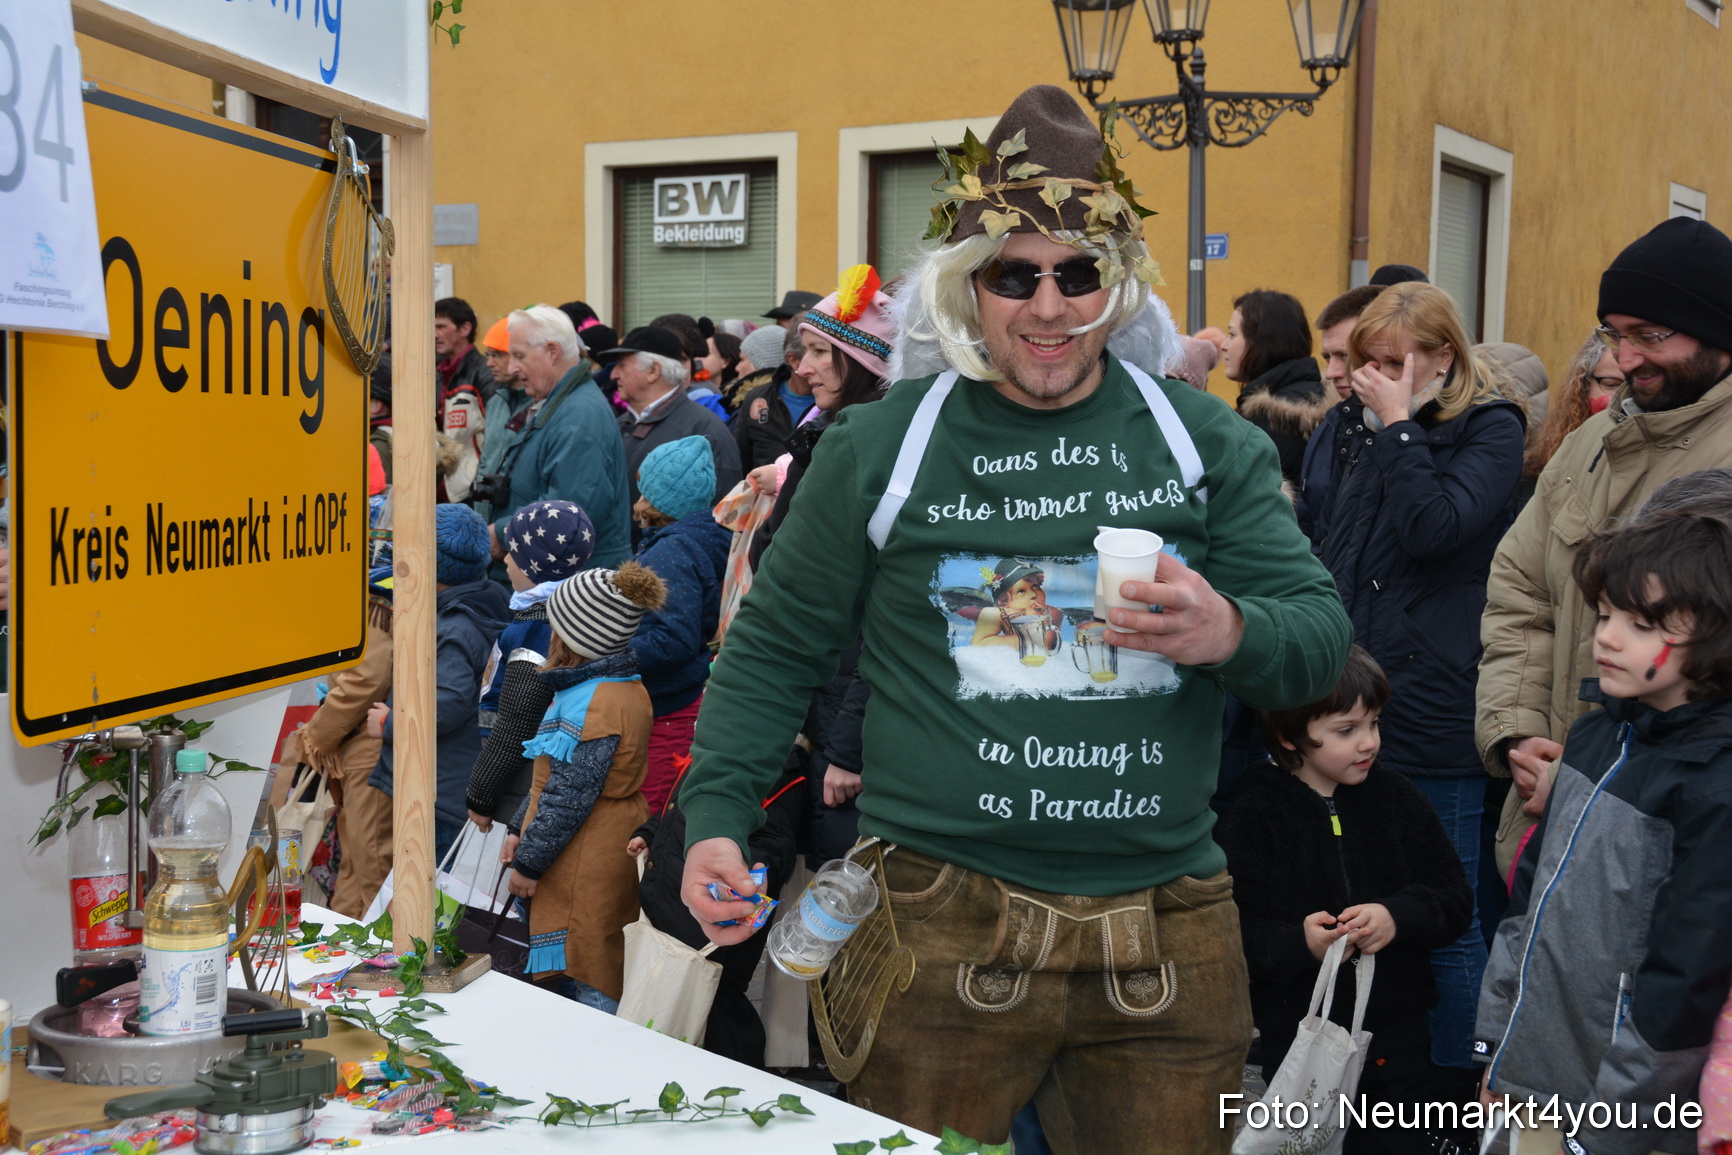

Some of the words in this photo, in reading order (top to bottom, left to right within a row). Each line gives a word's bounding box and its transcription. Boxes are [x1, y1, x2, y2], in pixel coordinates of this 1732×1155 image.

[658, 180, 741, 217] BW
[654, 223, 745, 245] Bekleidung
[1207, 244, 1220, 255] 17
[97, 236, 325, 435] Oening
[972, 449, 1038, 476] Oans
[1051, 437, 1100, 467] des
[1110, 443, 1129, 473] is
[927, 494, 996, 524] scho
[1003, 489, 1092, 521] immer
[1104, 479, 1186, 516] gwieß
[49, 504, 130, 587] Kreis
[146, 497, 271, 577] Neumarkt
[978, 737, 1015, 765] in
[1024, 735, 1134, 776] Oening
[1140, 737, 1164, 765] is
[978, 792, 1014, 819] as
[1028, 788, 1162, 822] Paradies
[92, 896, 128, 923] Schwepp
[75, 1060, 163, 1086] KARG
